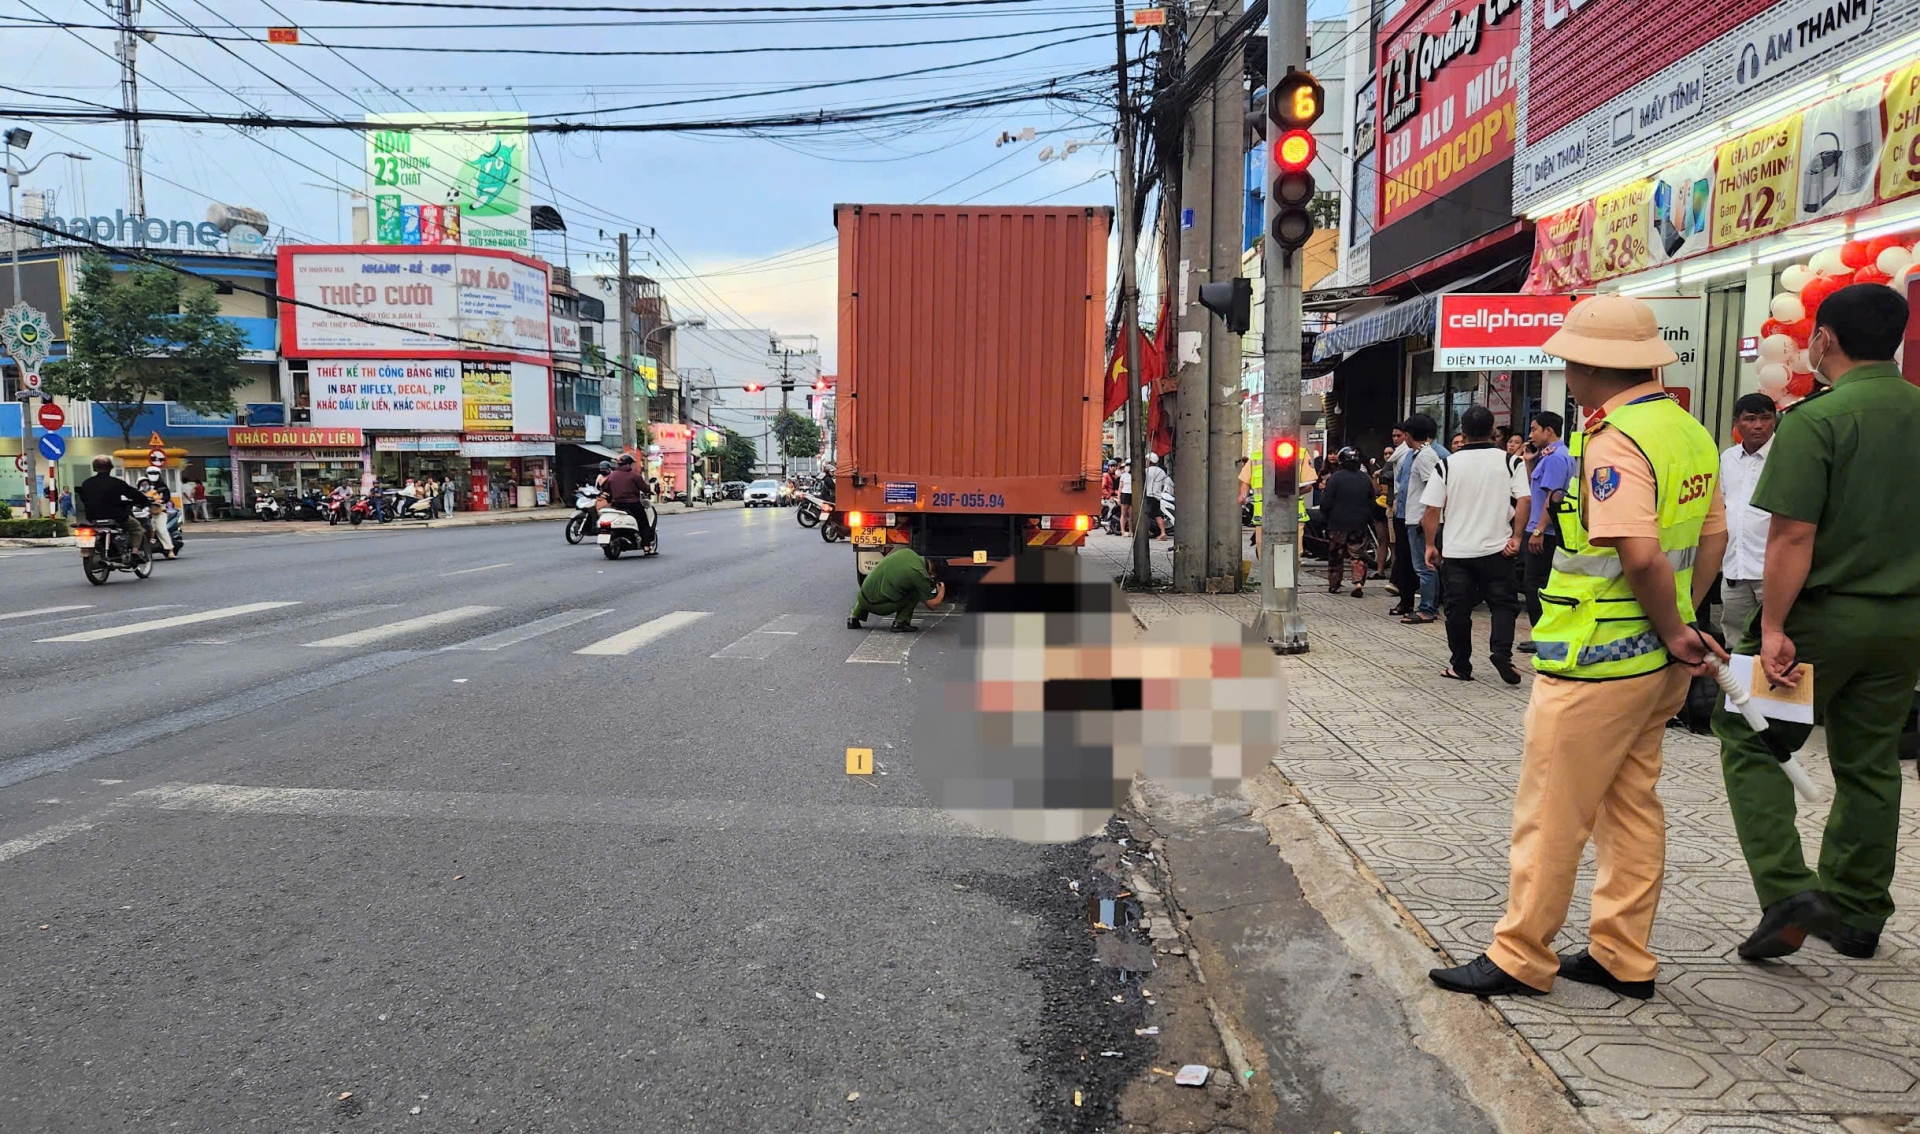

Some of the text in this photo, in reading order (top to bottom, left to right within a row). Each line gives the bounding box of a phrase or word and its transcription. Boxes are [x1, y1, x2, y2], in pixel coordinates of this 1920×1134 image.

[1797, 0, 1867, 48] THANH
[1383, 4, 1480, 118] 737 Quảng
[1296, 85, 1315, 119] 6
[1639, 78, 1699, 128] MÁY TÍNH
[1385, 128, 1411, 174] LED
[1420, 94, 1454, 150] ALU
[1385, 101, 1517, 215] PHOTOCOPY
[1535, 141, 1585, 181] ĐIỆN THOẠI
[375, 157, 399, 186] 23
[1760, 154, 1795, 181] MINH
[1605, 212, 1638, 235] LAPTOP
[362, 263, 400, 274] NHANH
[461, 268, 481, 288] IN
[486, 266, 510, 290] ÁO
[319, 282, 377, 307] THIỆP
[1447, 353, 1475, 368] ĐIỆN
[1479, 354, 1516, 367] THOẠI
[29, 374, 38, 386] 9
[317, 362, 455, 380] THIẾT KẾ THI CÔNG BẢNG HIỆU
[327, 384, 337, 394] IN
[360, 384, 396, 396] HIFLEX,
[398, 384, 431, 396] DECAL,
[433, 384, 446, 395] PP
[339, 396, 354, 410] DẤU
[356, 396, 369, 410] LẤY
[465, 404, 479, 420] IN
[235, 428, 355, 444] KHẮC DẤU LẤY LIỀN
[466, 434, 516, 442] PHOTOCOPY
[932, 493, 1005, 508] 29F-055.94
[854, 535, 882, 544] 055.94
[861, 527, 876, 536] 29F
[857, 754, 862, 770] 1
